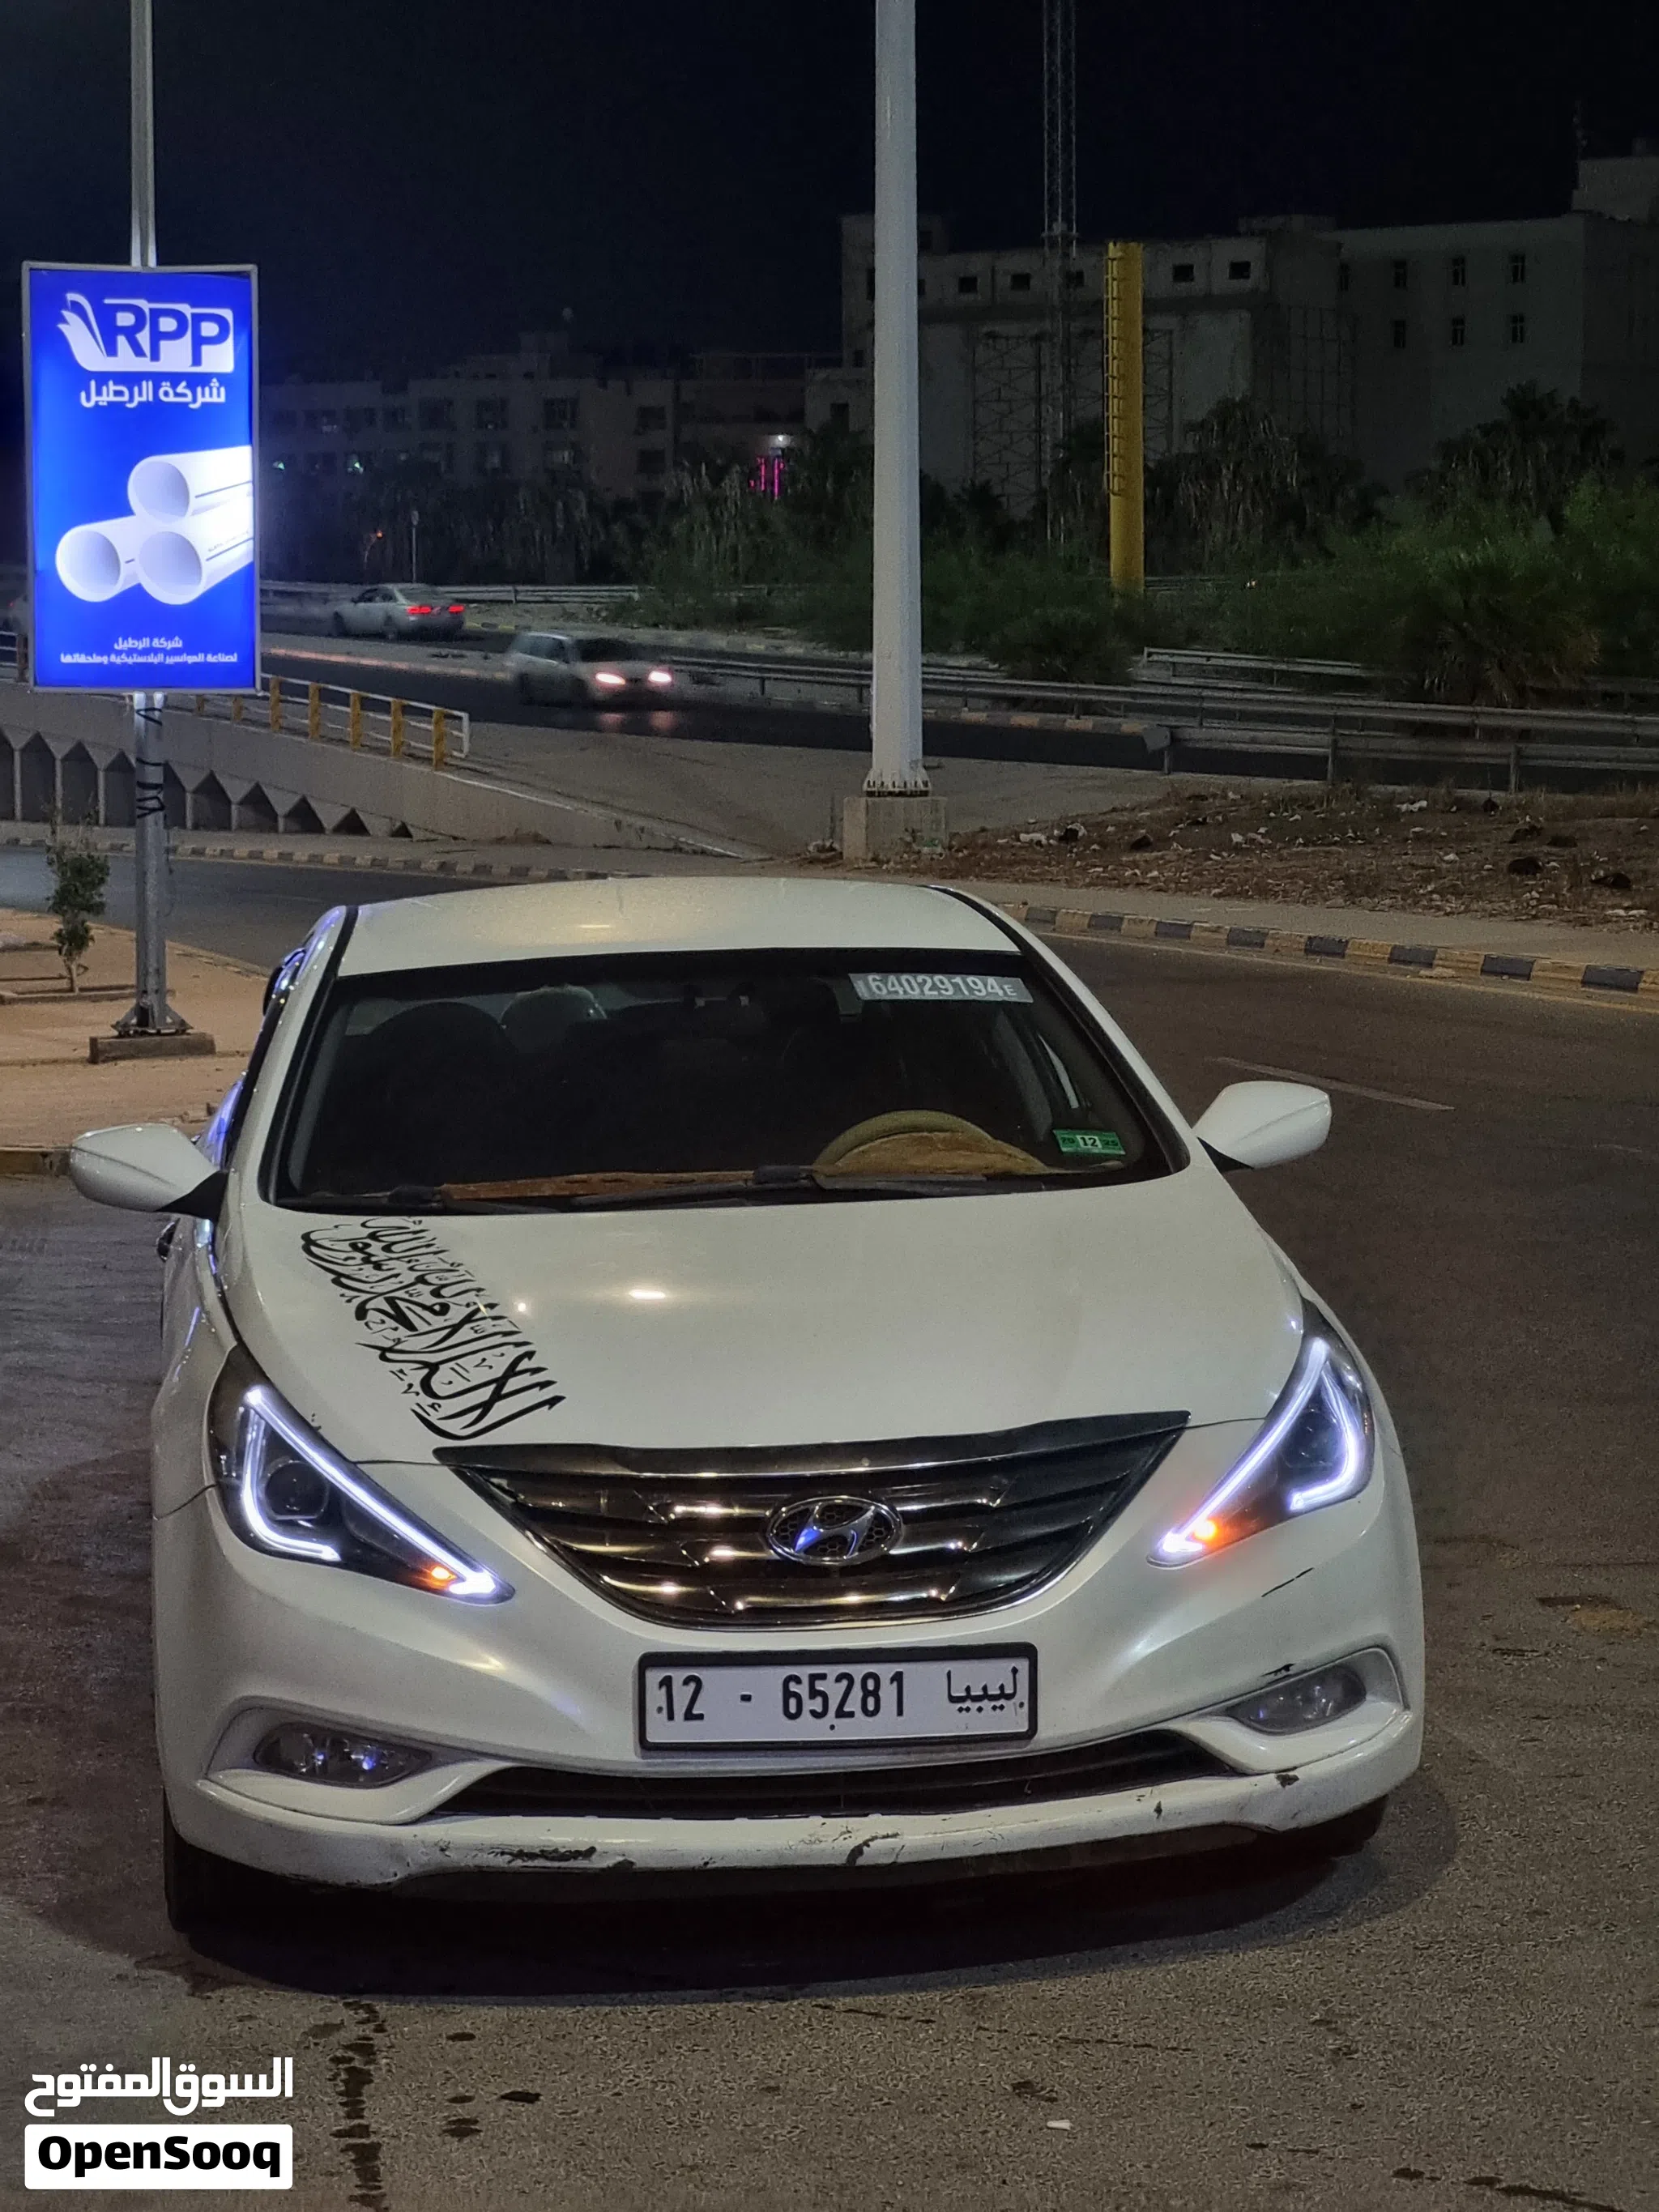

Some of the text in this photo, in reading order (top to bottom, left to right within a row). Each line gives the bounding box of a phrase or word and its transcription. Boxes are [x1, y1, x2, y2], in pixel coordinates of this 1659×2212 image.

[104, 302, 230, 368] RPP
[80, 377, 225, 409] شركة الرطيل
[113, 636, 183, 650] شركة الرطيل
[206, 652, 238, 663] لصناعة
[1080, 1136, 1098, 1148] 12
[658, 1674, 705, 1721] 12
[782, 1670, 905, 1720] 65281
[946, 1665, 1019, 1714] ليبيا
